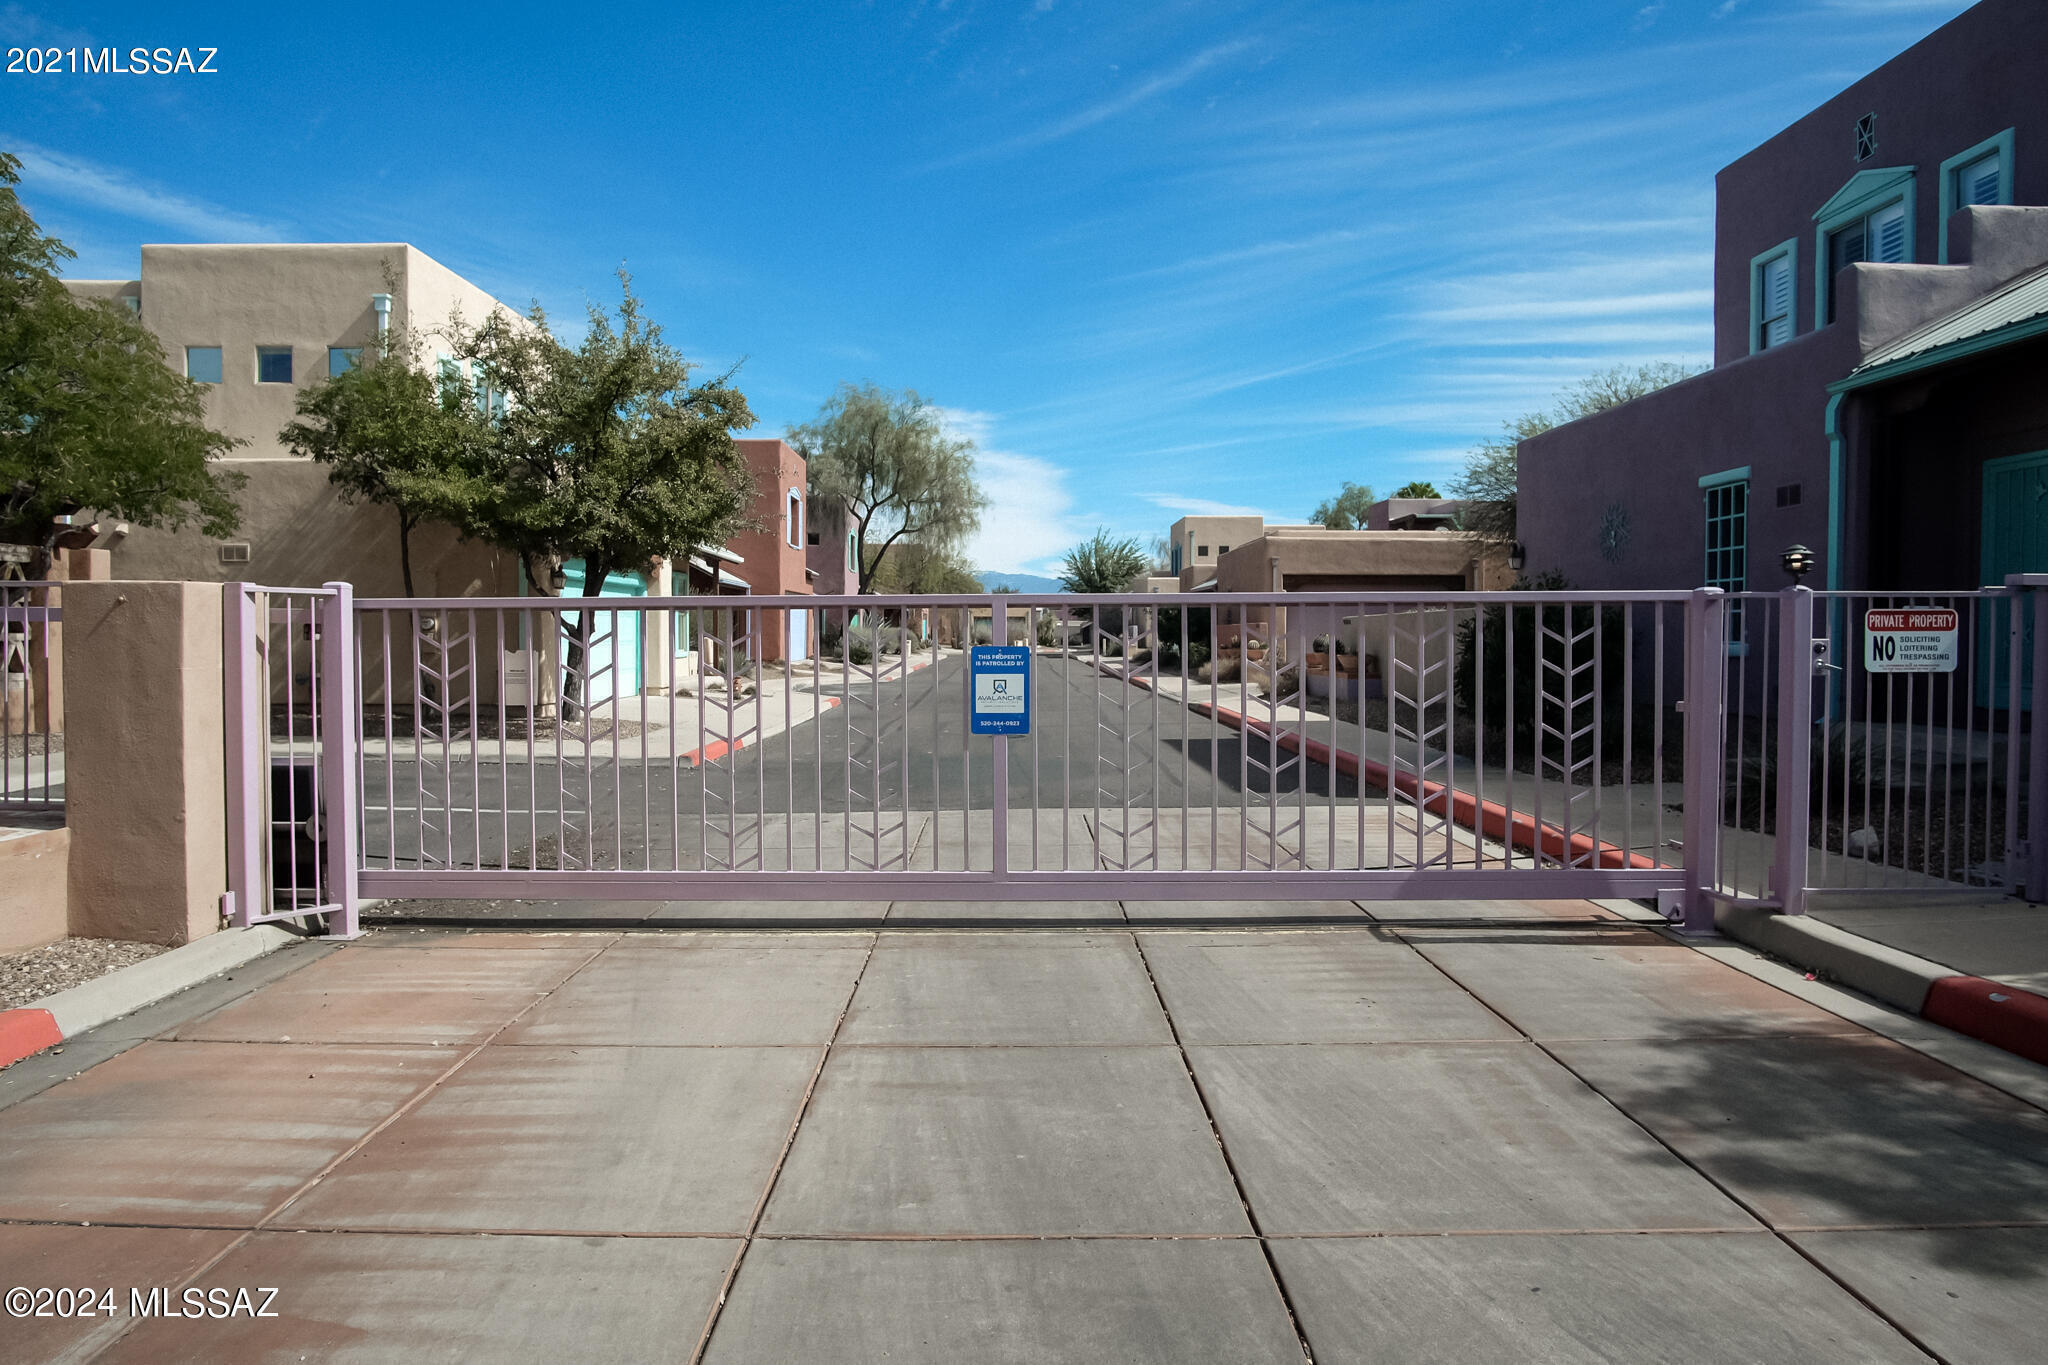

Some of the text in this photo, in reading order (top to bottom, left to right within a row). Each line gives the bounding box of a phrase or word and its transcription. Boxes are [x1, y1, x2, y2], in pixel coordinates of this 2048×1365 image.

[1869, 614, 1954, 628] PRIVATE PROPERTY
[1873, 635, 1896, 661] NO
